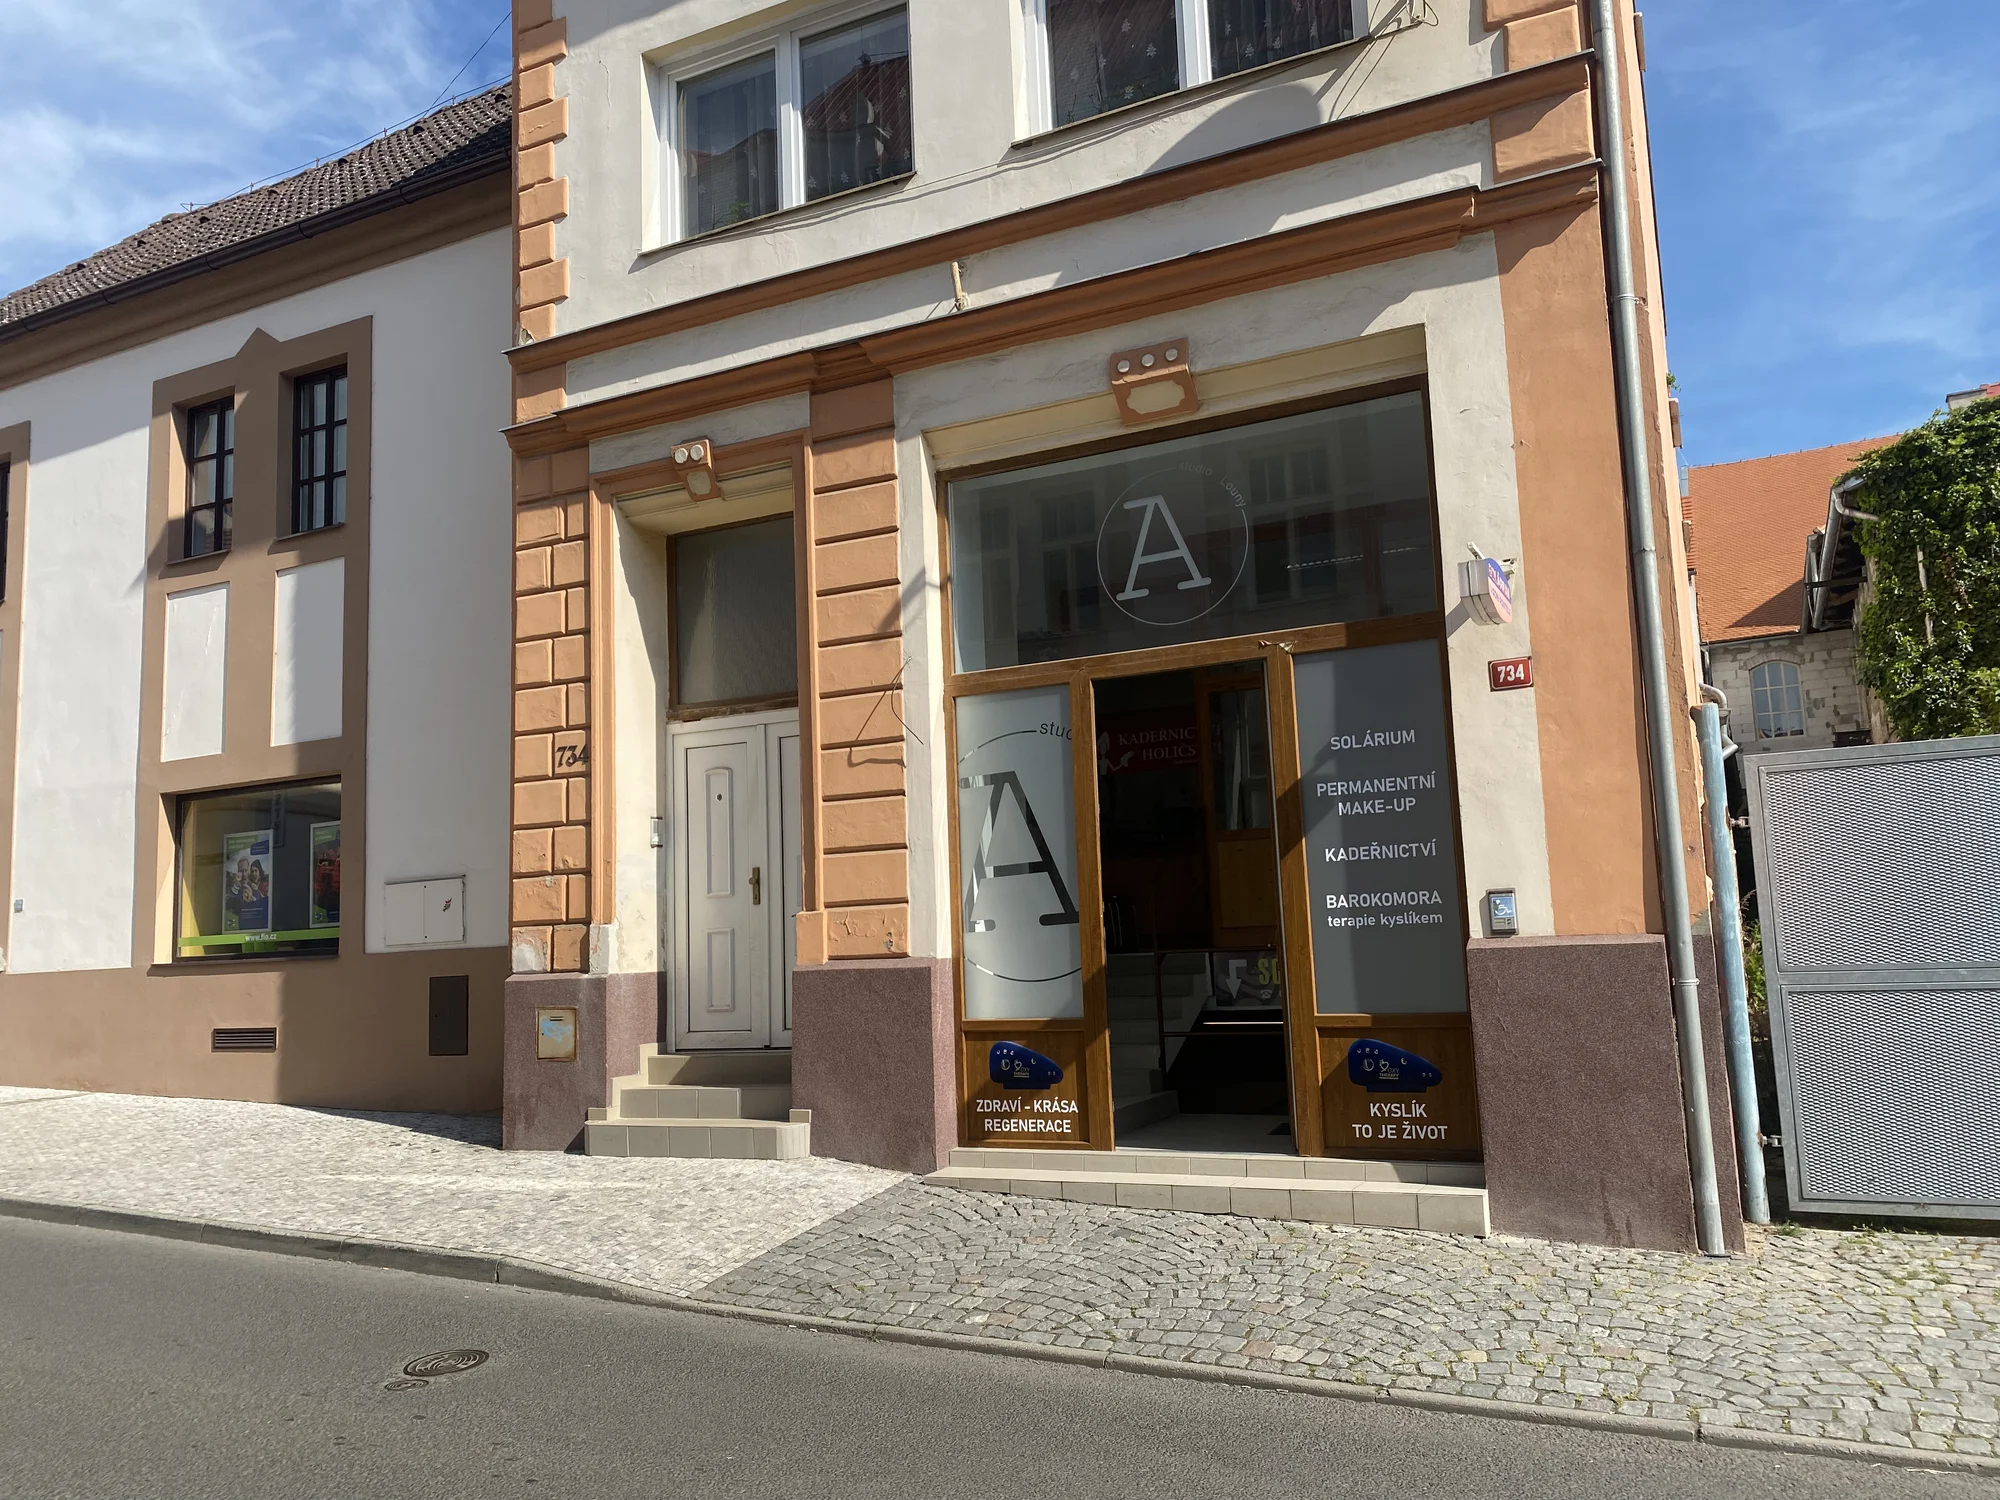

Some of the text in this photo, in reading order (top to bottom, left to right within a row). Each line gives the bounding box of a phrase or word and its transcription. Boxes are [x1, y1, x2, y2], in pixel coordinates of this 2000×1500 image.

[1219, 475, 1247, 508] Louny
[1116, 494, 1212, 600] A
[1497, 663, 1525, 683] 734
[1119, 726, 1198, 746] KADEŘNIC
[1330, 729, 1416, 750] SOLÁRIUM
[555, 744, 590, 769] 734
[1142, 743, 1199, 761] HOLIČS
[1316, 771, 1436, 797] PERMANENTNÍ
[1338, 797, 1417, 816] MAKE-UP
[1325, 839, 1436, 862] KADEŘNICTVÍ
[1326, 890, 1442, 909] BAROKOMORA
[1327, 911, 1443, 929] terapie kyslíkem
[244, 933, 277, 942] www.fio.cz
[976, 1096, 1021, 1112] ZDRAVÍ
[1033, 1096, 1079, 1113] KRÁSA
[1369, 1099, 1427, 1118] KYSLÍK
[984, 1118, 1072, 1132] REGENERACE
[1351, 1120, 1448, 1139] TO JE ŽIVOT
